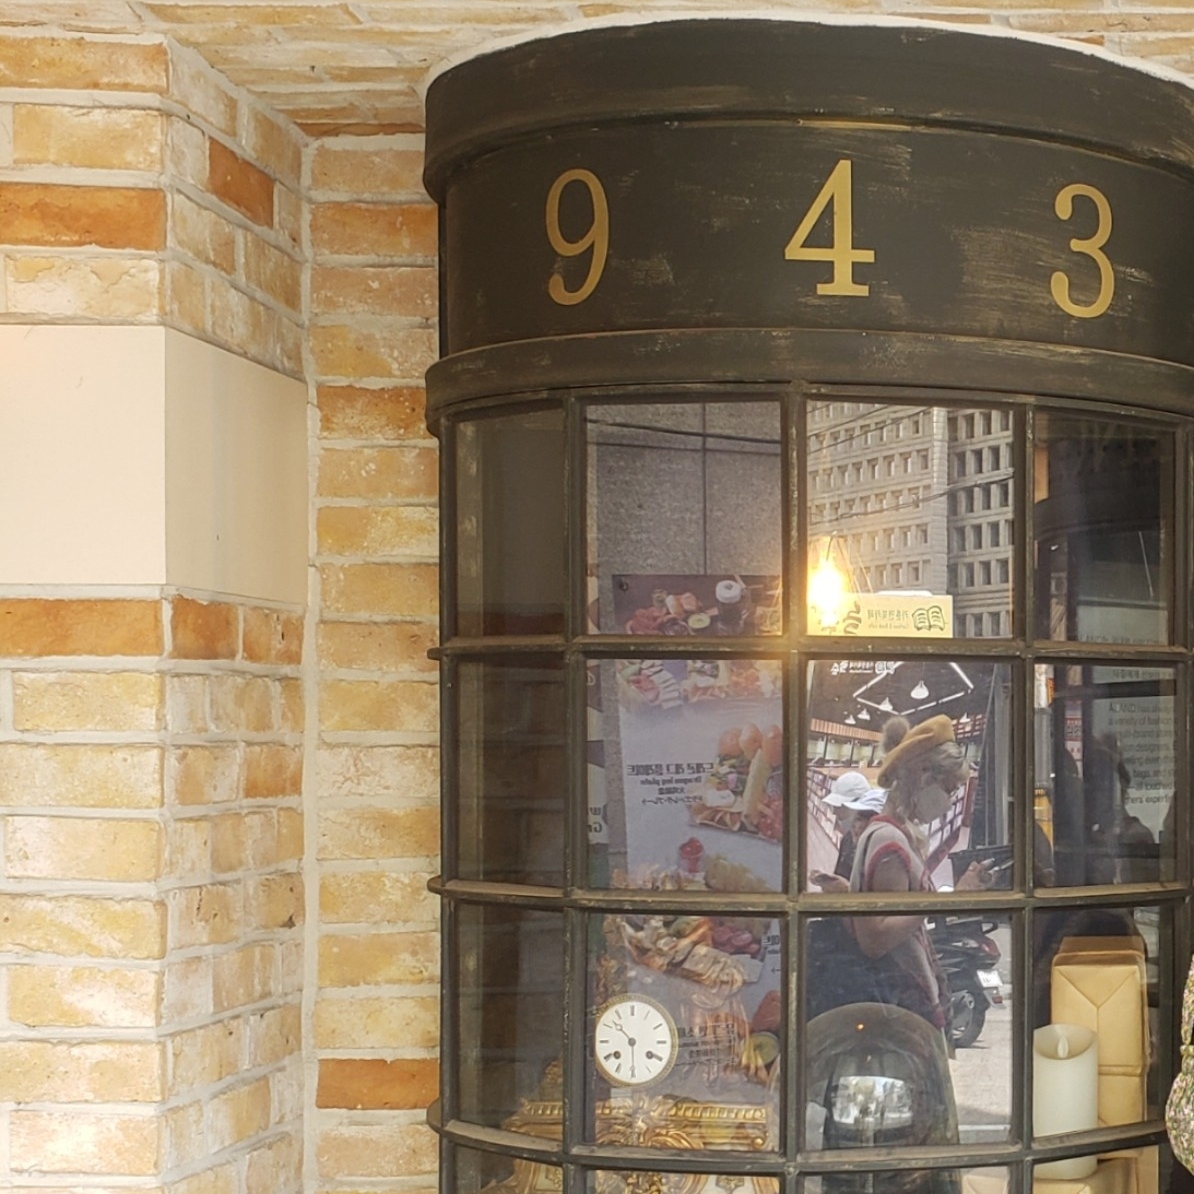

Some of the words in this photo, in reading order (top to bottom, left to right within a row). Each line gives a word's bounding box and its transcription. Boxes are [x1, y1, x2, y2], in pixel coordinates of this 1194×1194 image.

[546, 168, 610, 307] 9
[784, 159, 876, 297] 4
[1049, 182, 1116, 319] 3
